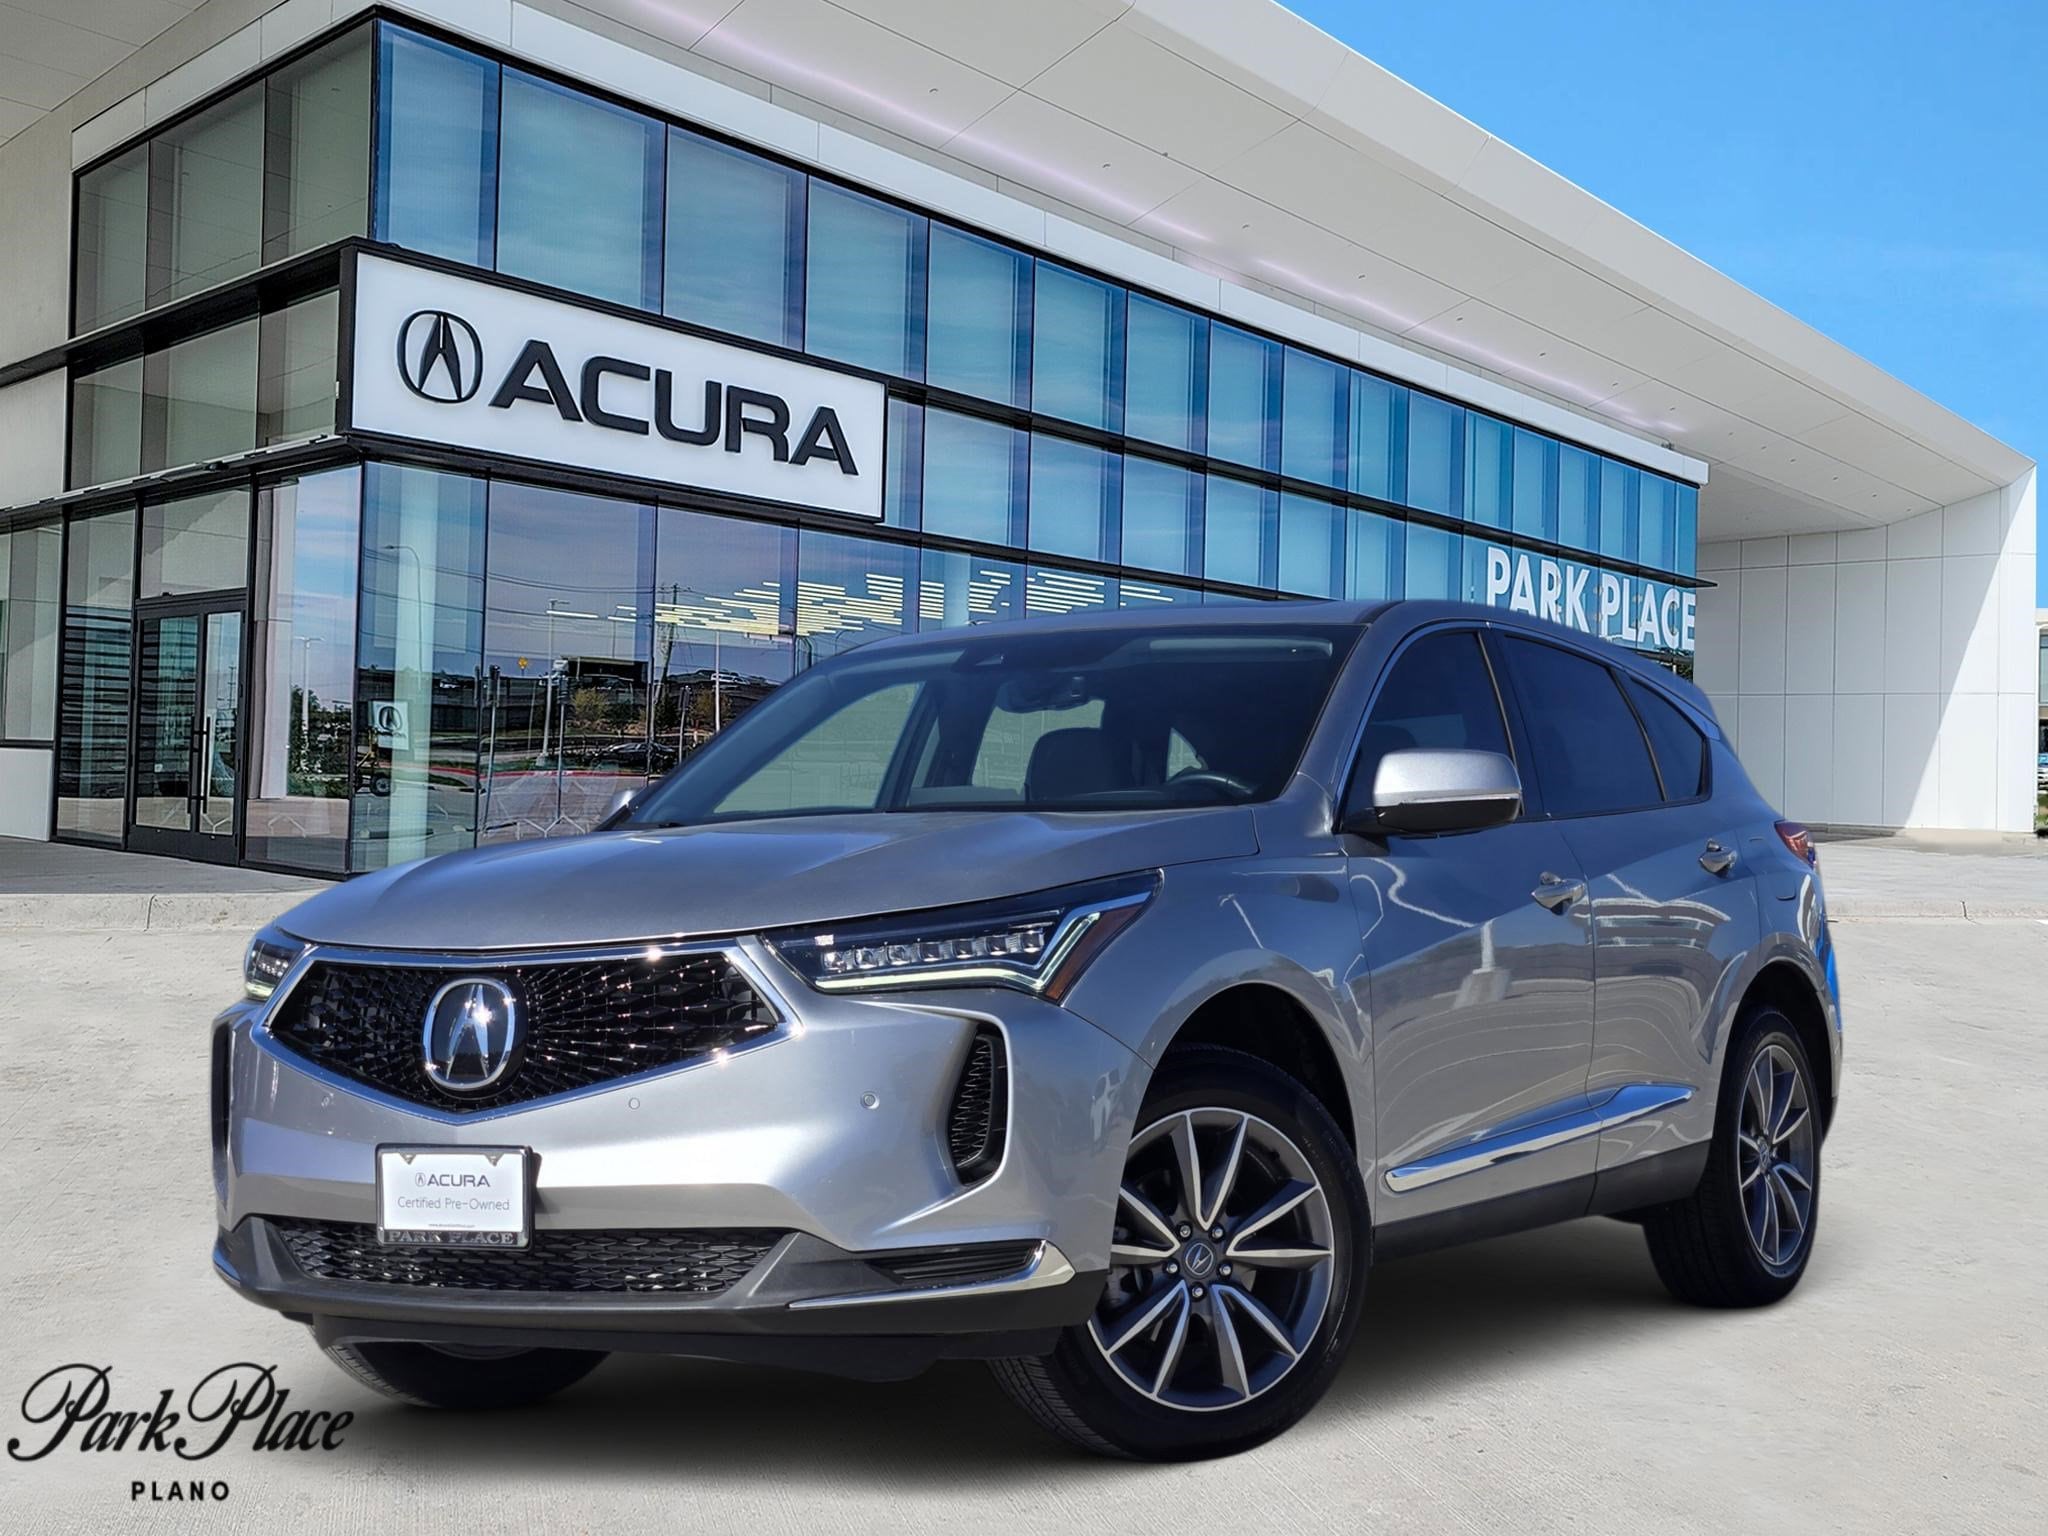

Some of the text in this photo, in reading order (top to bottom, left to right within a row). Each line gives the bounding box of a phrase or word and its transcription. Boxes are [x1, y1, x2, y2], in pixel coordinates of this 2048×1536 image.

[488, 339, 859, 476] ACURA
[1487, 546, 1696, 651] PARK PLACE
[427, 1173, 491, 1188] ACURA
[397, 1196, 510, 1211] Certified Pre-Owned
[388, 1230, 514, 1245] PARK PLACE
